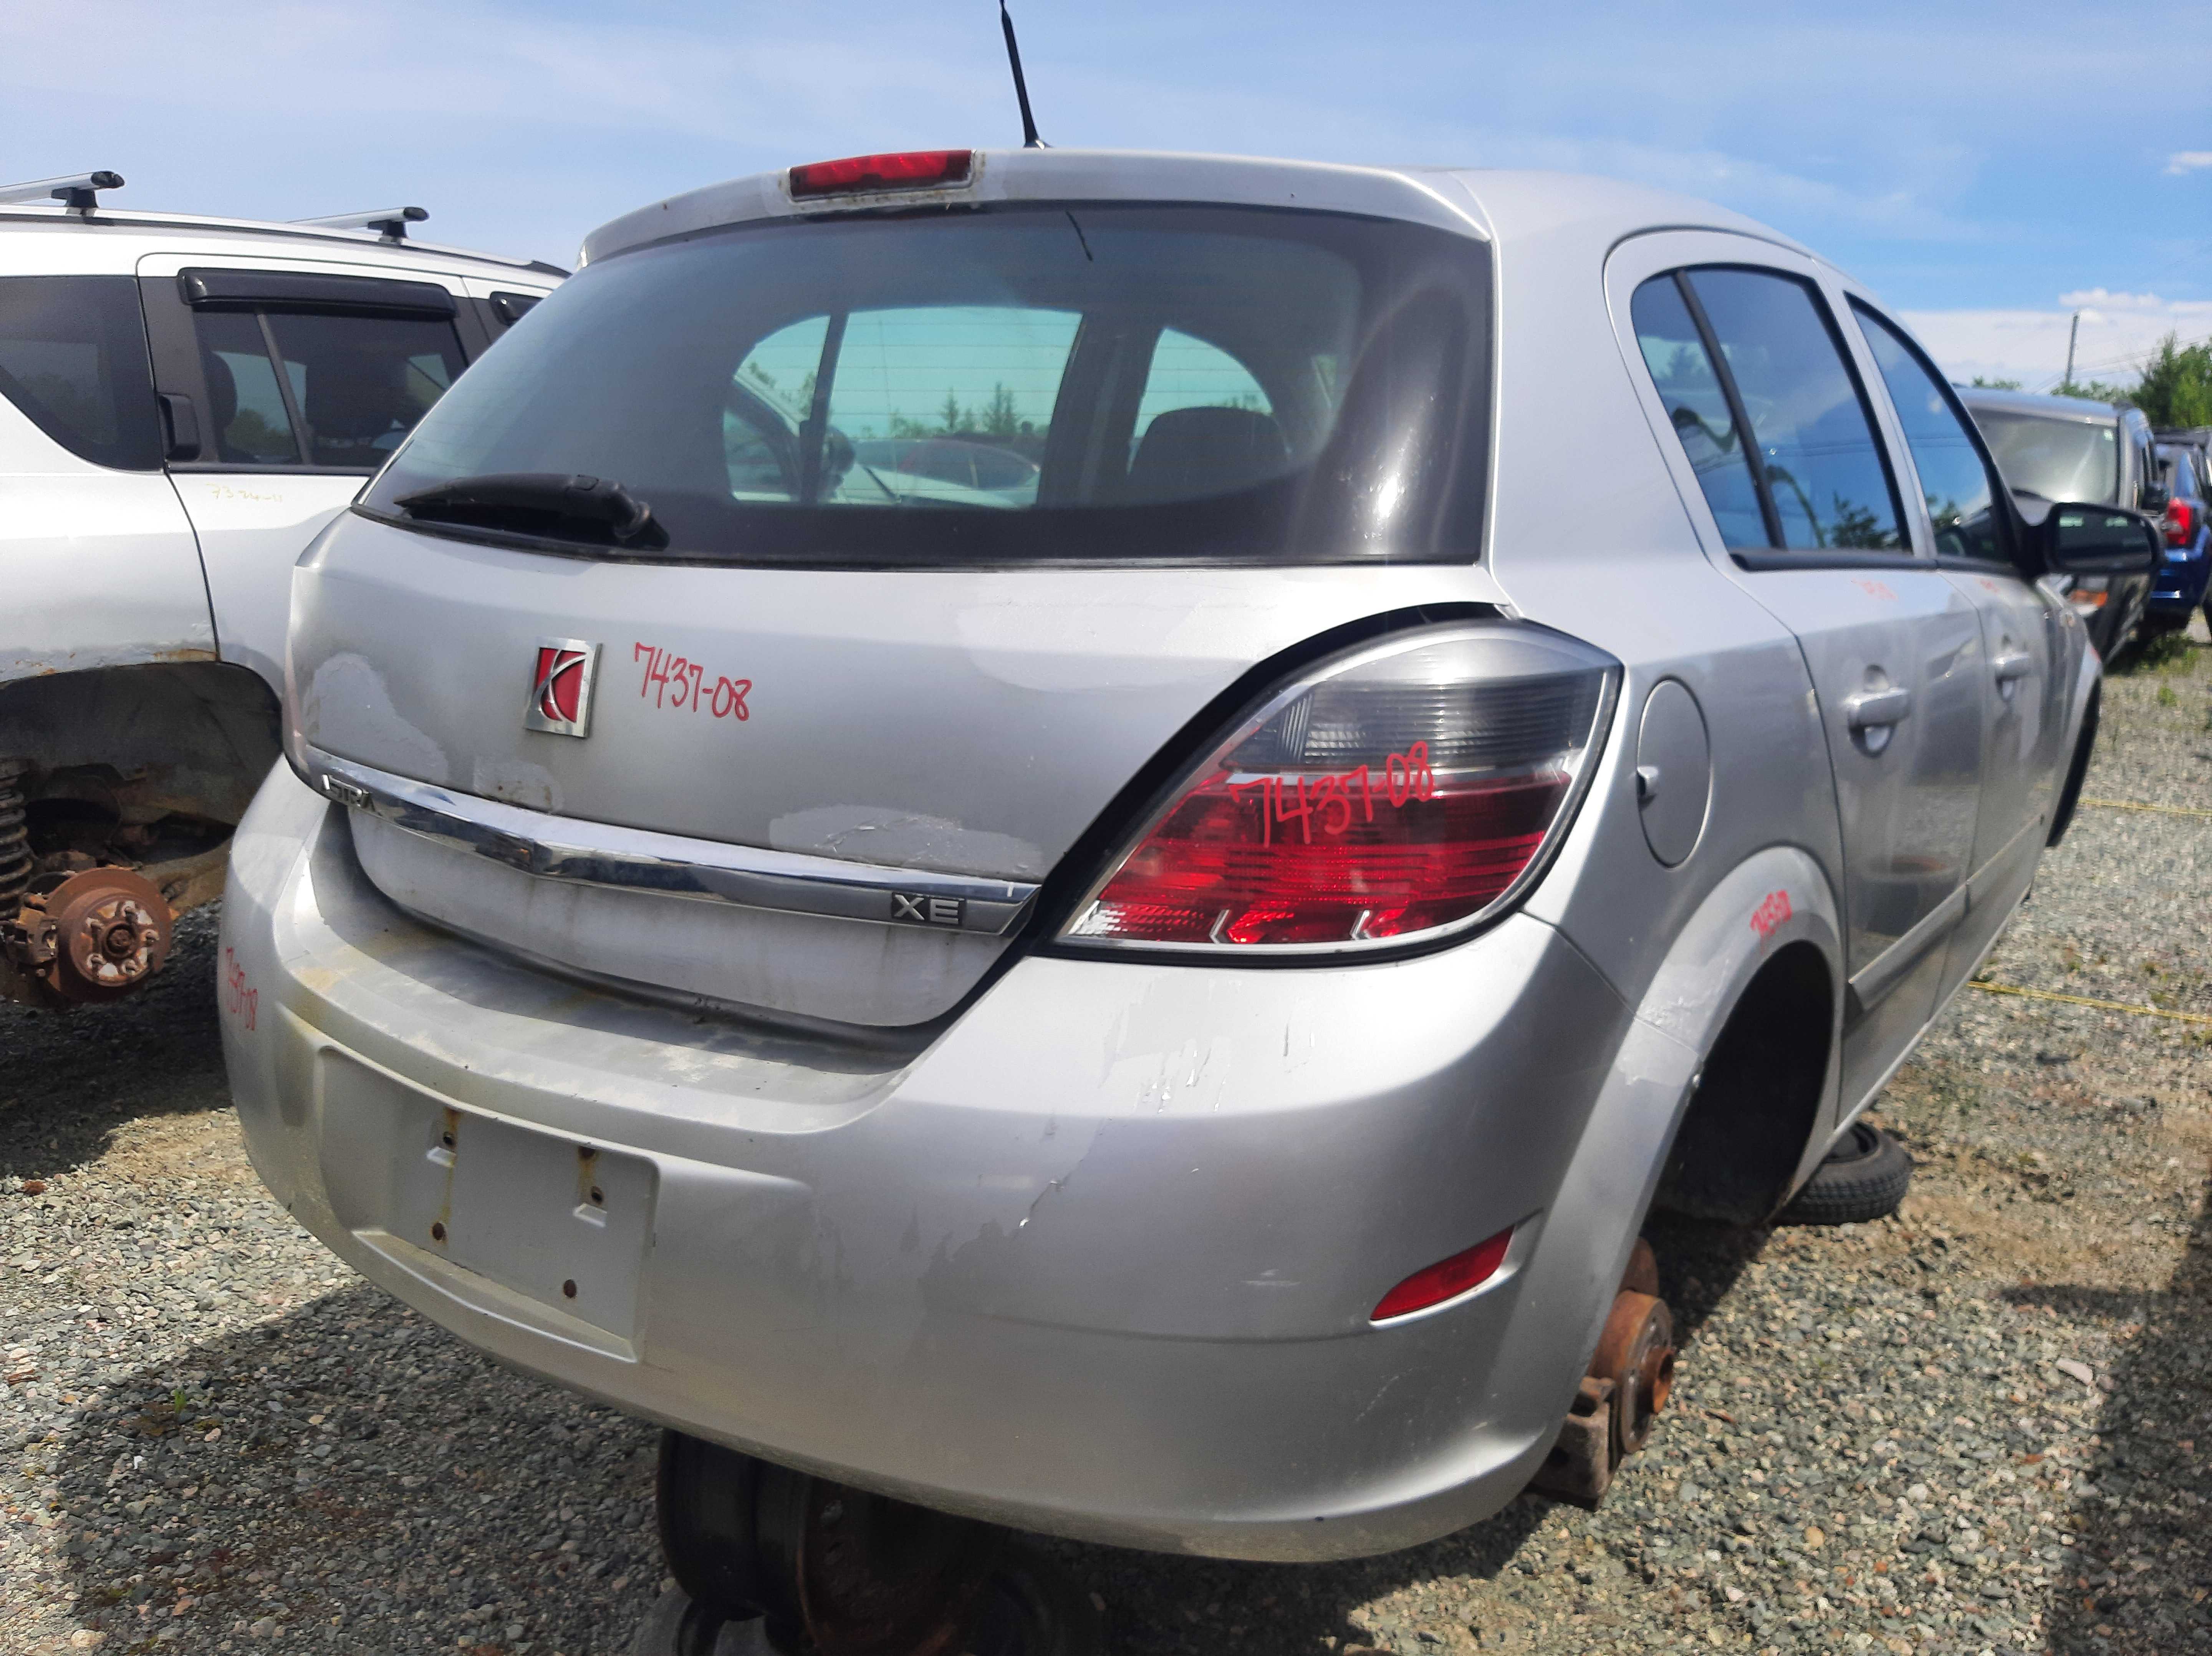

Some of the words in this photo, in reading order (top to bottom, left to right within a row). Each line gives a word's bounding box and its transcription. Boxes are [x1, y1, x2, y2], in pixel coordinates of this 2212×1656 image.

[634, 641, 753, 722] 7437-08
[1229, 740, 1434, 848] 7437-08
[893, 894, 960, 925] XE
